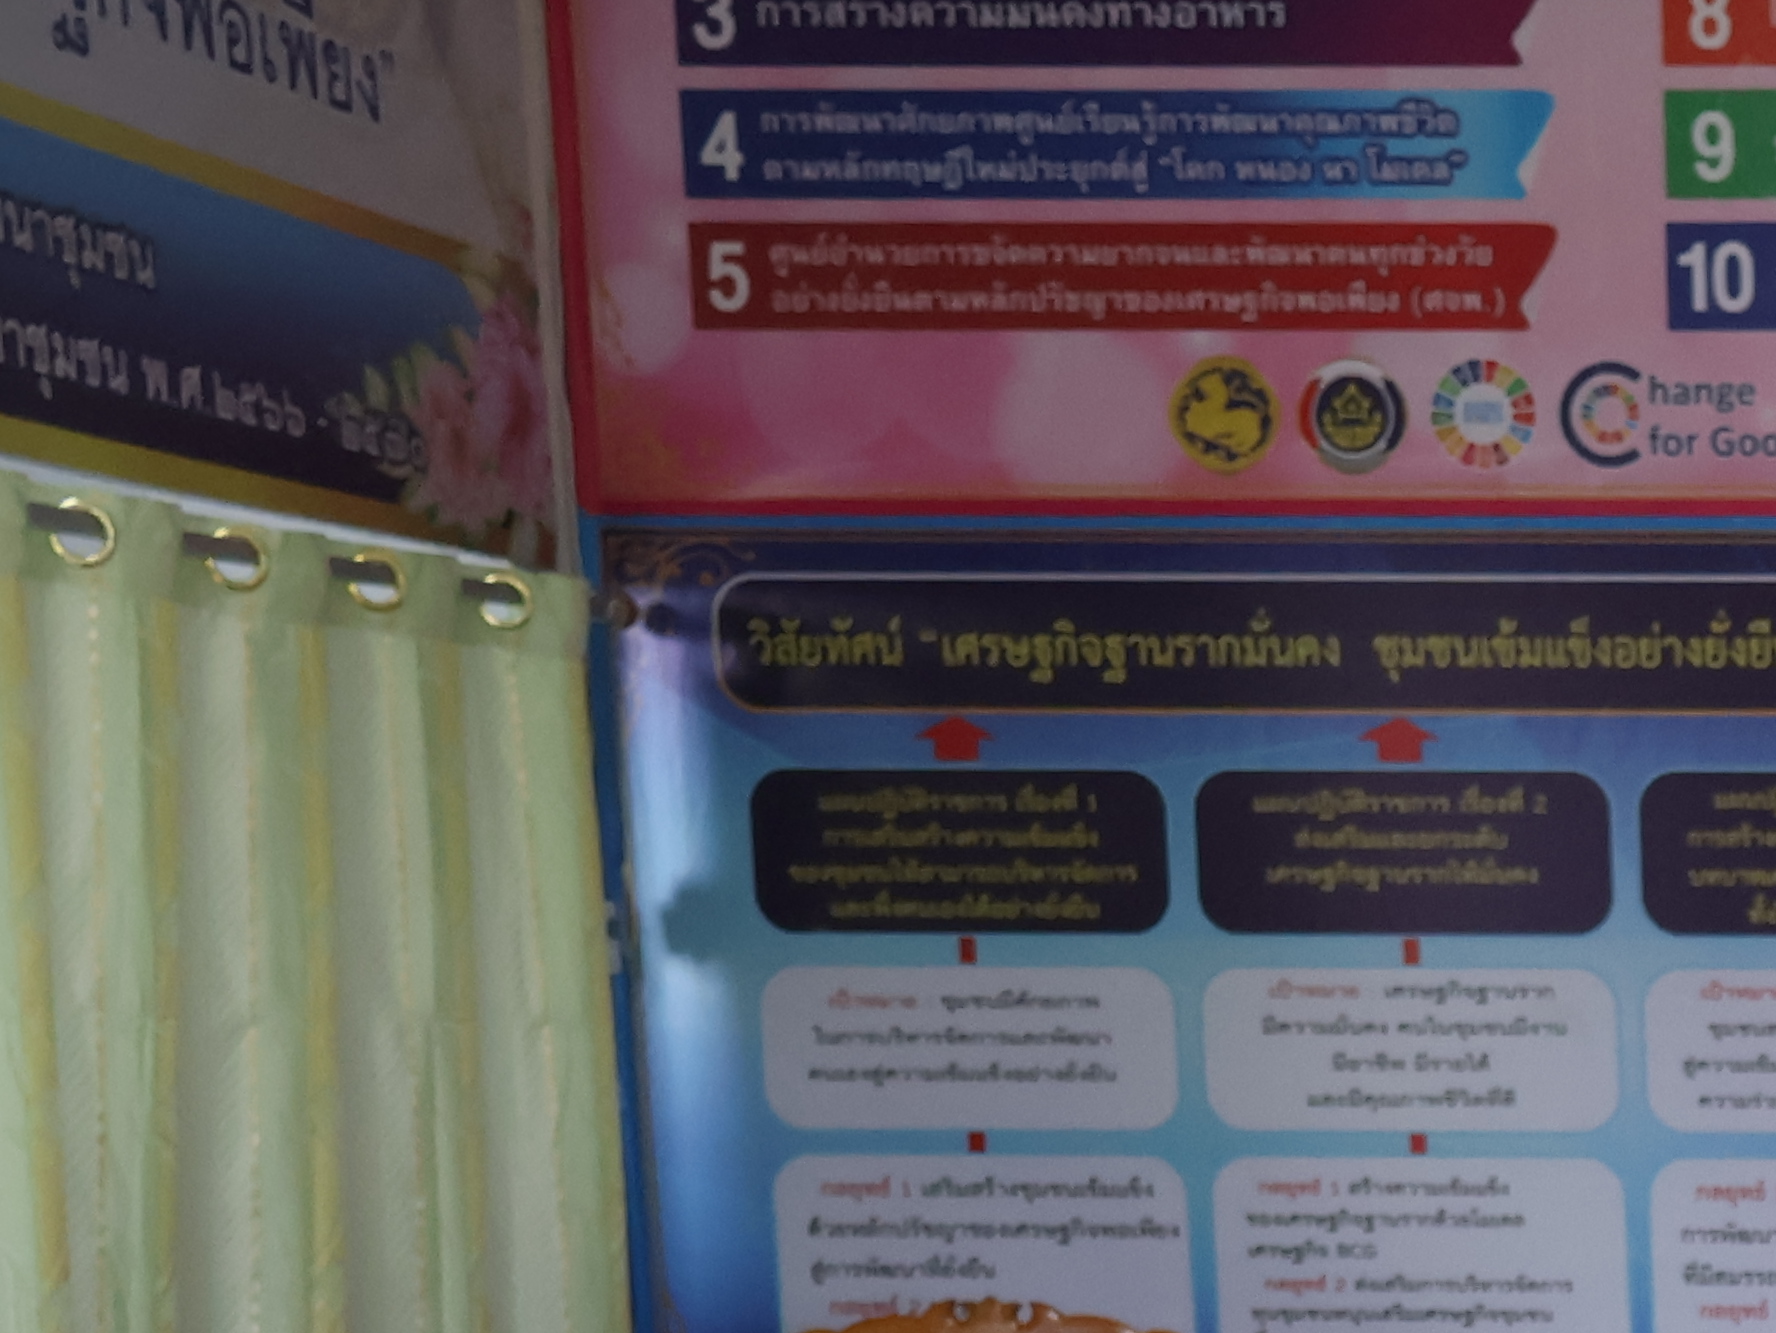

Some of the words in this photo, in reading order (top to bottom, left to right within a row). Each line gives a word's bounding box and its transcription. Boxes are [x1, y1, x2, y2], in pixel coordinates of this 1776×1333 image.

[693, 0, 736, 50] 3
[698, 109, 745, 183] 4
[1689, 111, 1736, 181] 9
[0, 200, 156, 290] นาชุมชน
[707, 241, 750, 312] 5
[1675, 242, 1755, 314] 10
[1649, 424, 1699, 457] for
[746, 612, 904, 669] วิสัยทัศน์
